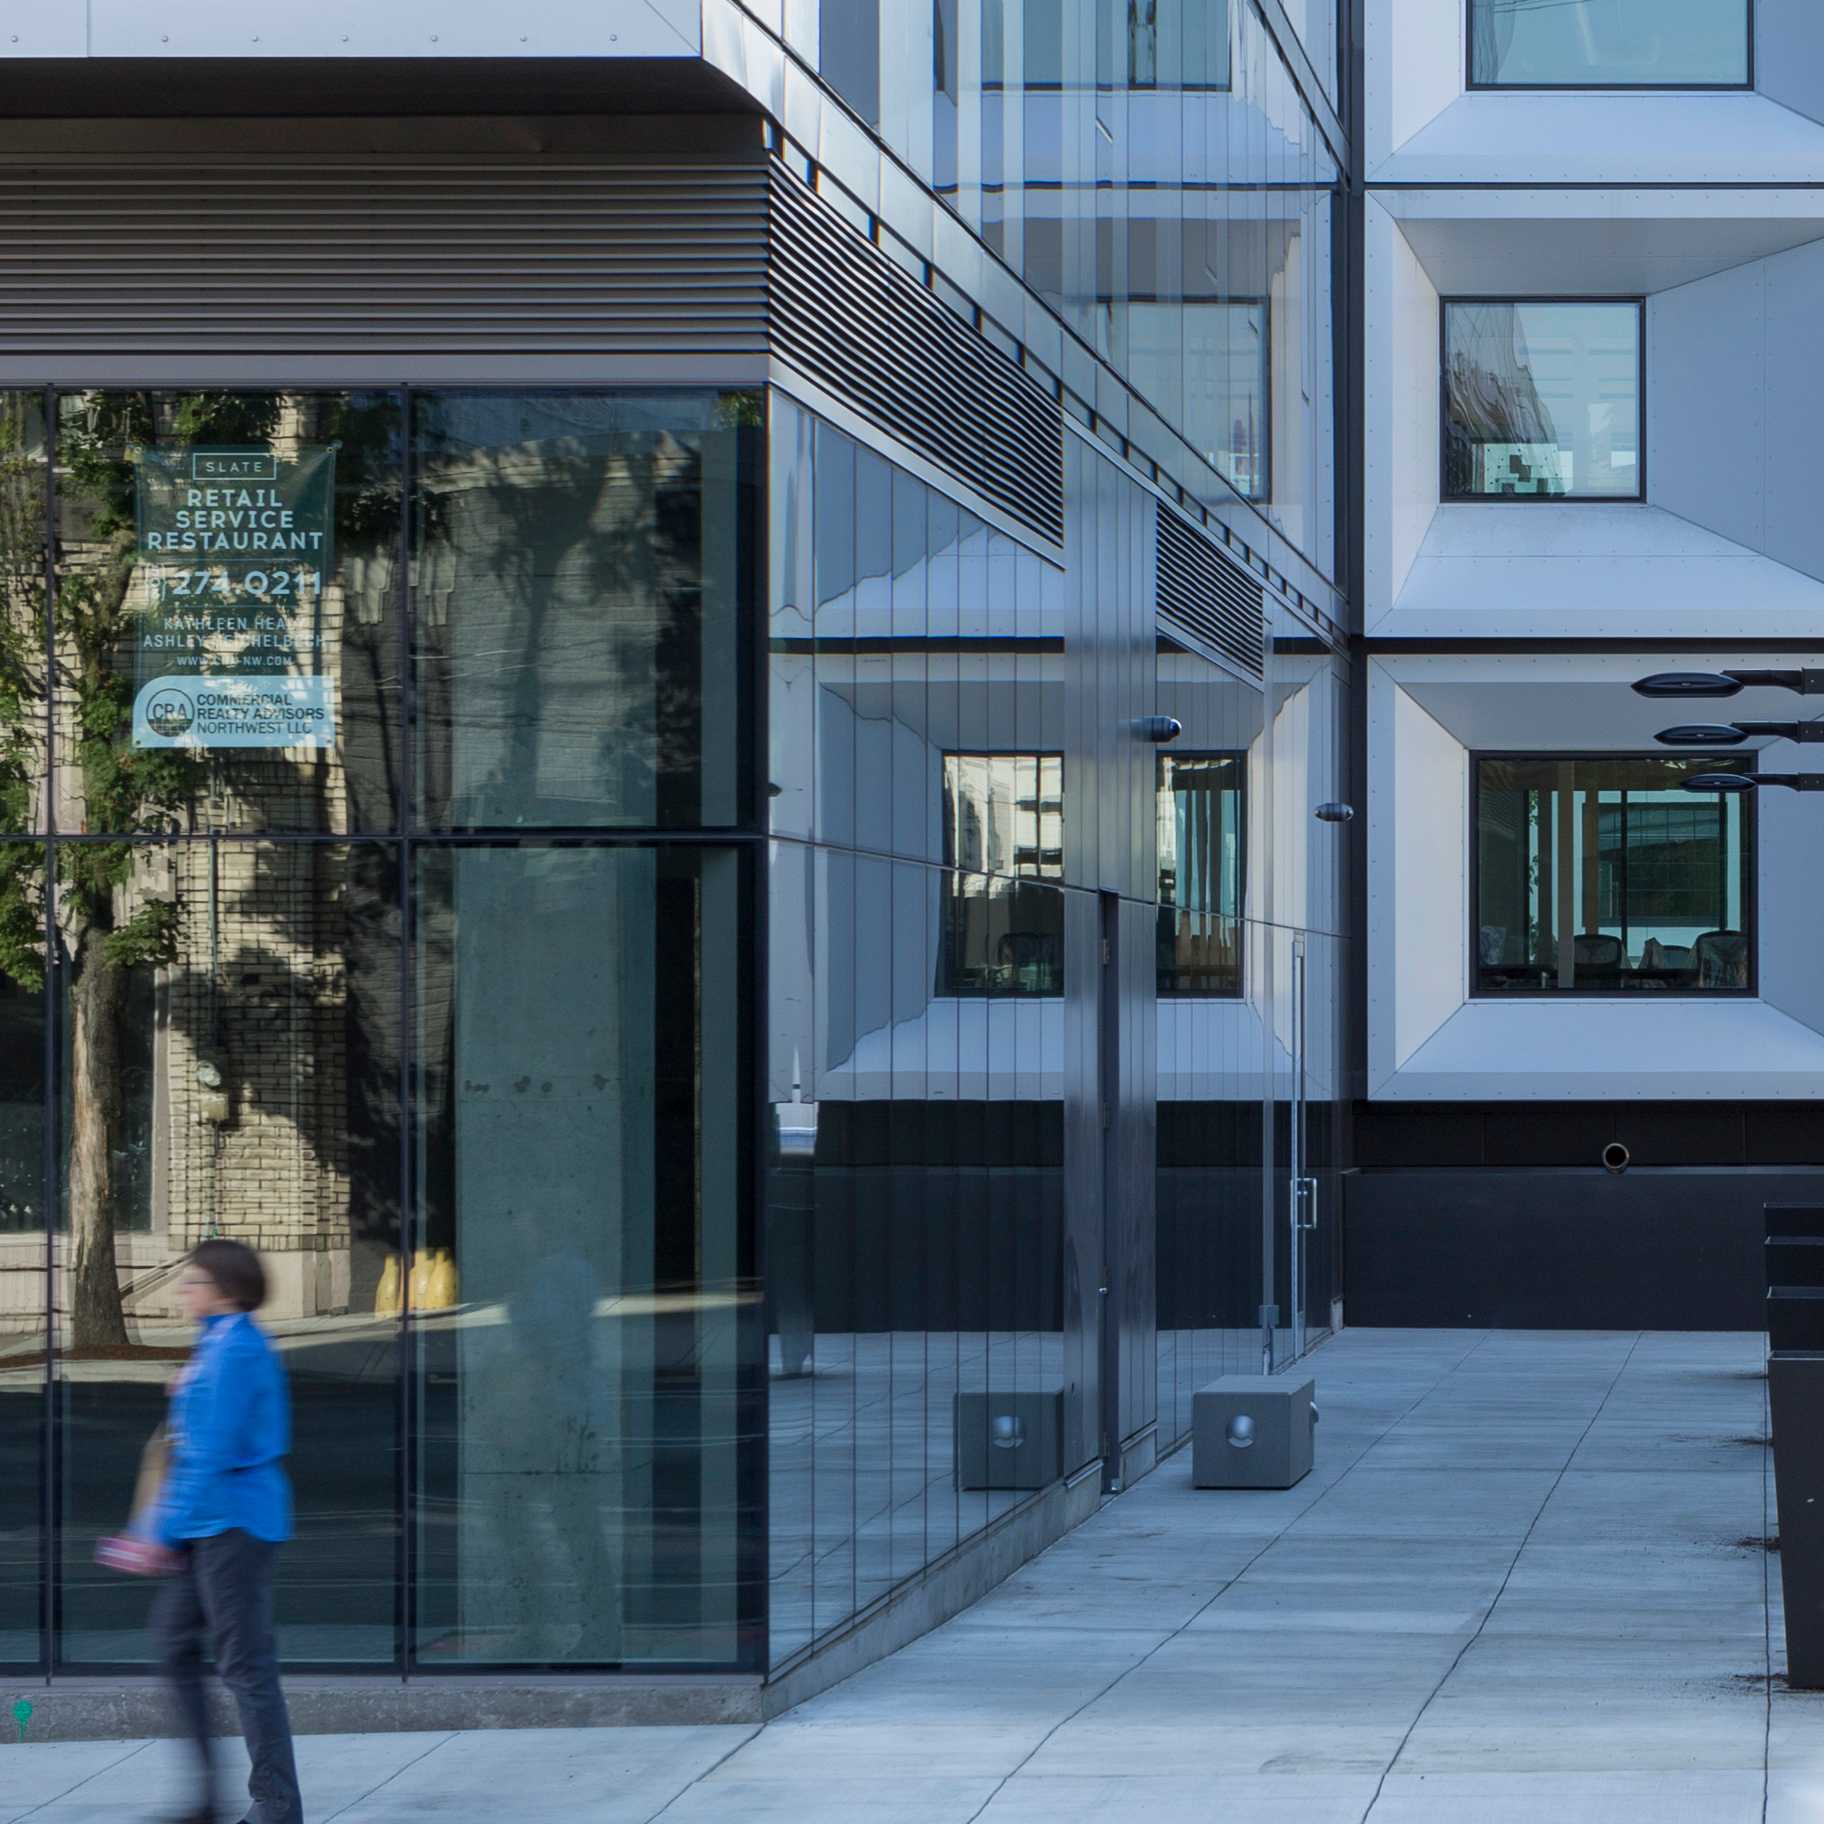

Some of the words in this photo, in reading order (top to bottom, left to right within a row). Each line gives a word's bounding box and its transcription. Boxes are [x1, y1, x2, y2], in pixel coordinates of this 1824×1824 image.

[206, 461, 262, 473] SLATE
[187, 489, 283, 507] RETAIL
[176, 511, 293, 529] SERVICE
[148, 532, 323, 550] RESTAURANT
[173, 570, 321, 596] 274.0211
[164, 617, 247, 630] KATHLEEN
[143, 634, 204, 648] ASHLEY
[196, 694, 293, 706] COMMERCIAL
[152, 703, 188, 720] CRA
[196, 707, 250, 720] REALTY
[253, 707, 326, 720] ADVISORS
[196, 721, 284, 735] NORTHWEST
[287, 721, 313, 734] LLC
